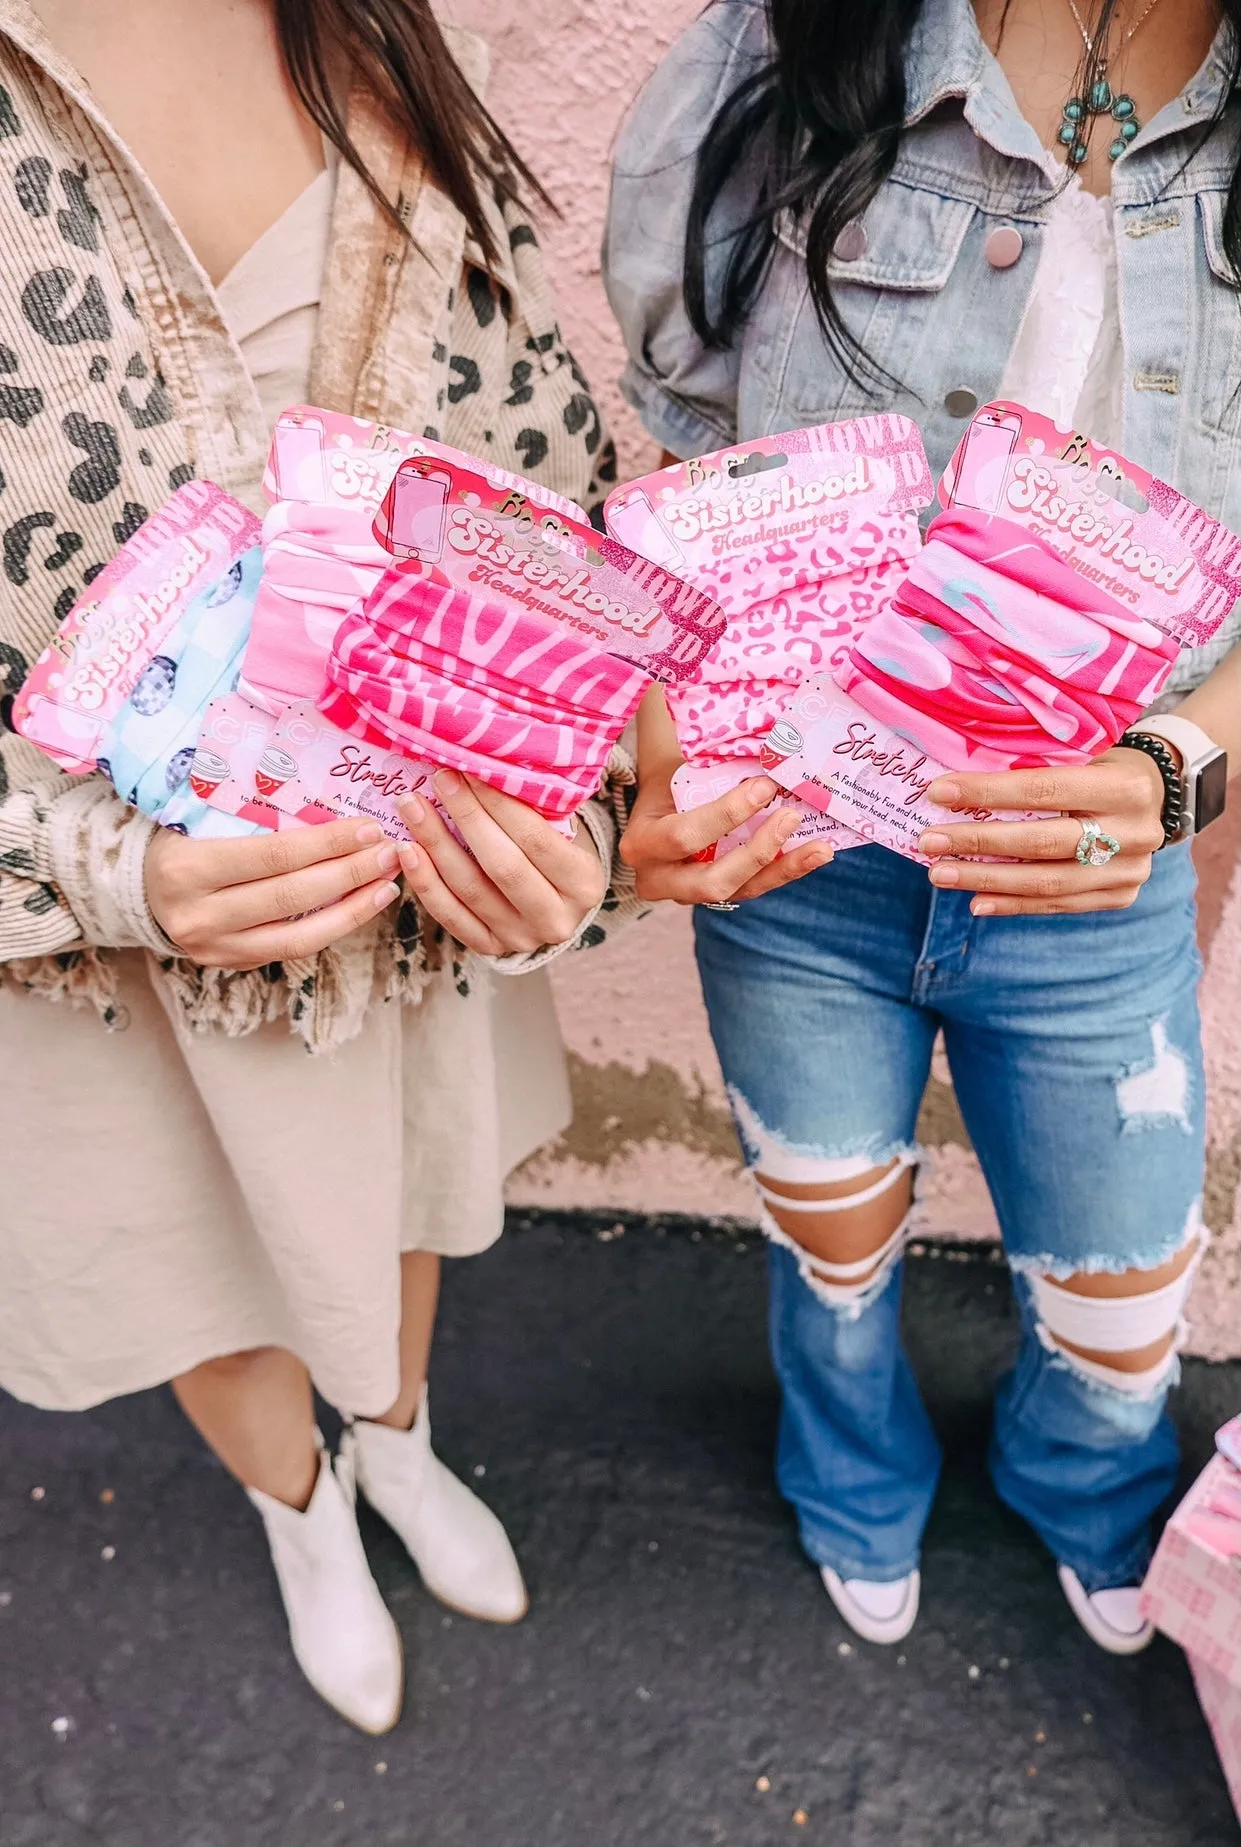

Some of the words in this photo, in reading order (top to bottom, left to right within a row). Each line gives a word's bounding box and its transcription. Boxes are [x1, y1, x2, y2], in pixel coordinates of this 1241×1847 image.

[664, 456, 872, 545] Sisterhood
[1006, 457, 1197, 595] Sisterhood
[711, 509, 849, 556] Headquarters
[447, 508, 664, 638] Sisterhood
[64, 535, 210, 710] Sisterhood
[468, 564, 609, 642] Headquarters
[329, 745, 428, 797] Stretc
[832, 721, 933, 806] Stretchy
[240, 795, 250, 803] to
[252, 796, 264, 807] be
[265, 801, 285, 813] wo
[303, 795, 312, 804] to
[313, 798, 325, 809] be
[327, 805, 346, 818] worn
[332, 793, 342, 803] A
[344, 795, 389, 823] Fashionably
[390, 815, 405, 829] Fun
[802, 772, 810, 781] to
[811, 775, 822, 787] be
[823, 783, 840, 797] worn
[841, 793, 851, 802] on
[851, 798, 868, 810] your
[869, 804, 889, 823] head,
[890, 819, 907, 833] neck,
[831, 771, 840, 781] A
[841, 774, 882, 803] Fashionably
[882, 796, 896, 810] Fun
[896, 807, 913, 818] and
[383, 829, 400, 841] ead,
[796, 828, 814, 839] your
[816, 820, 839, 833] head,
